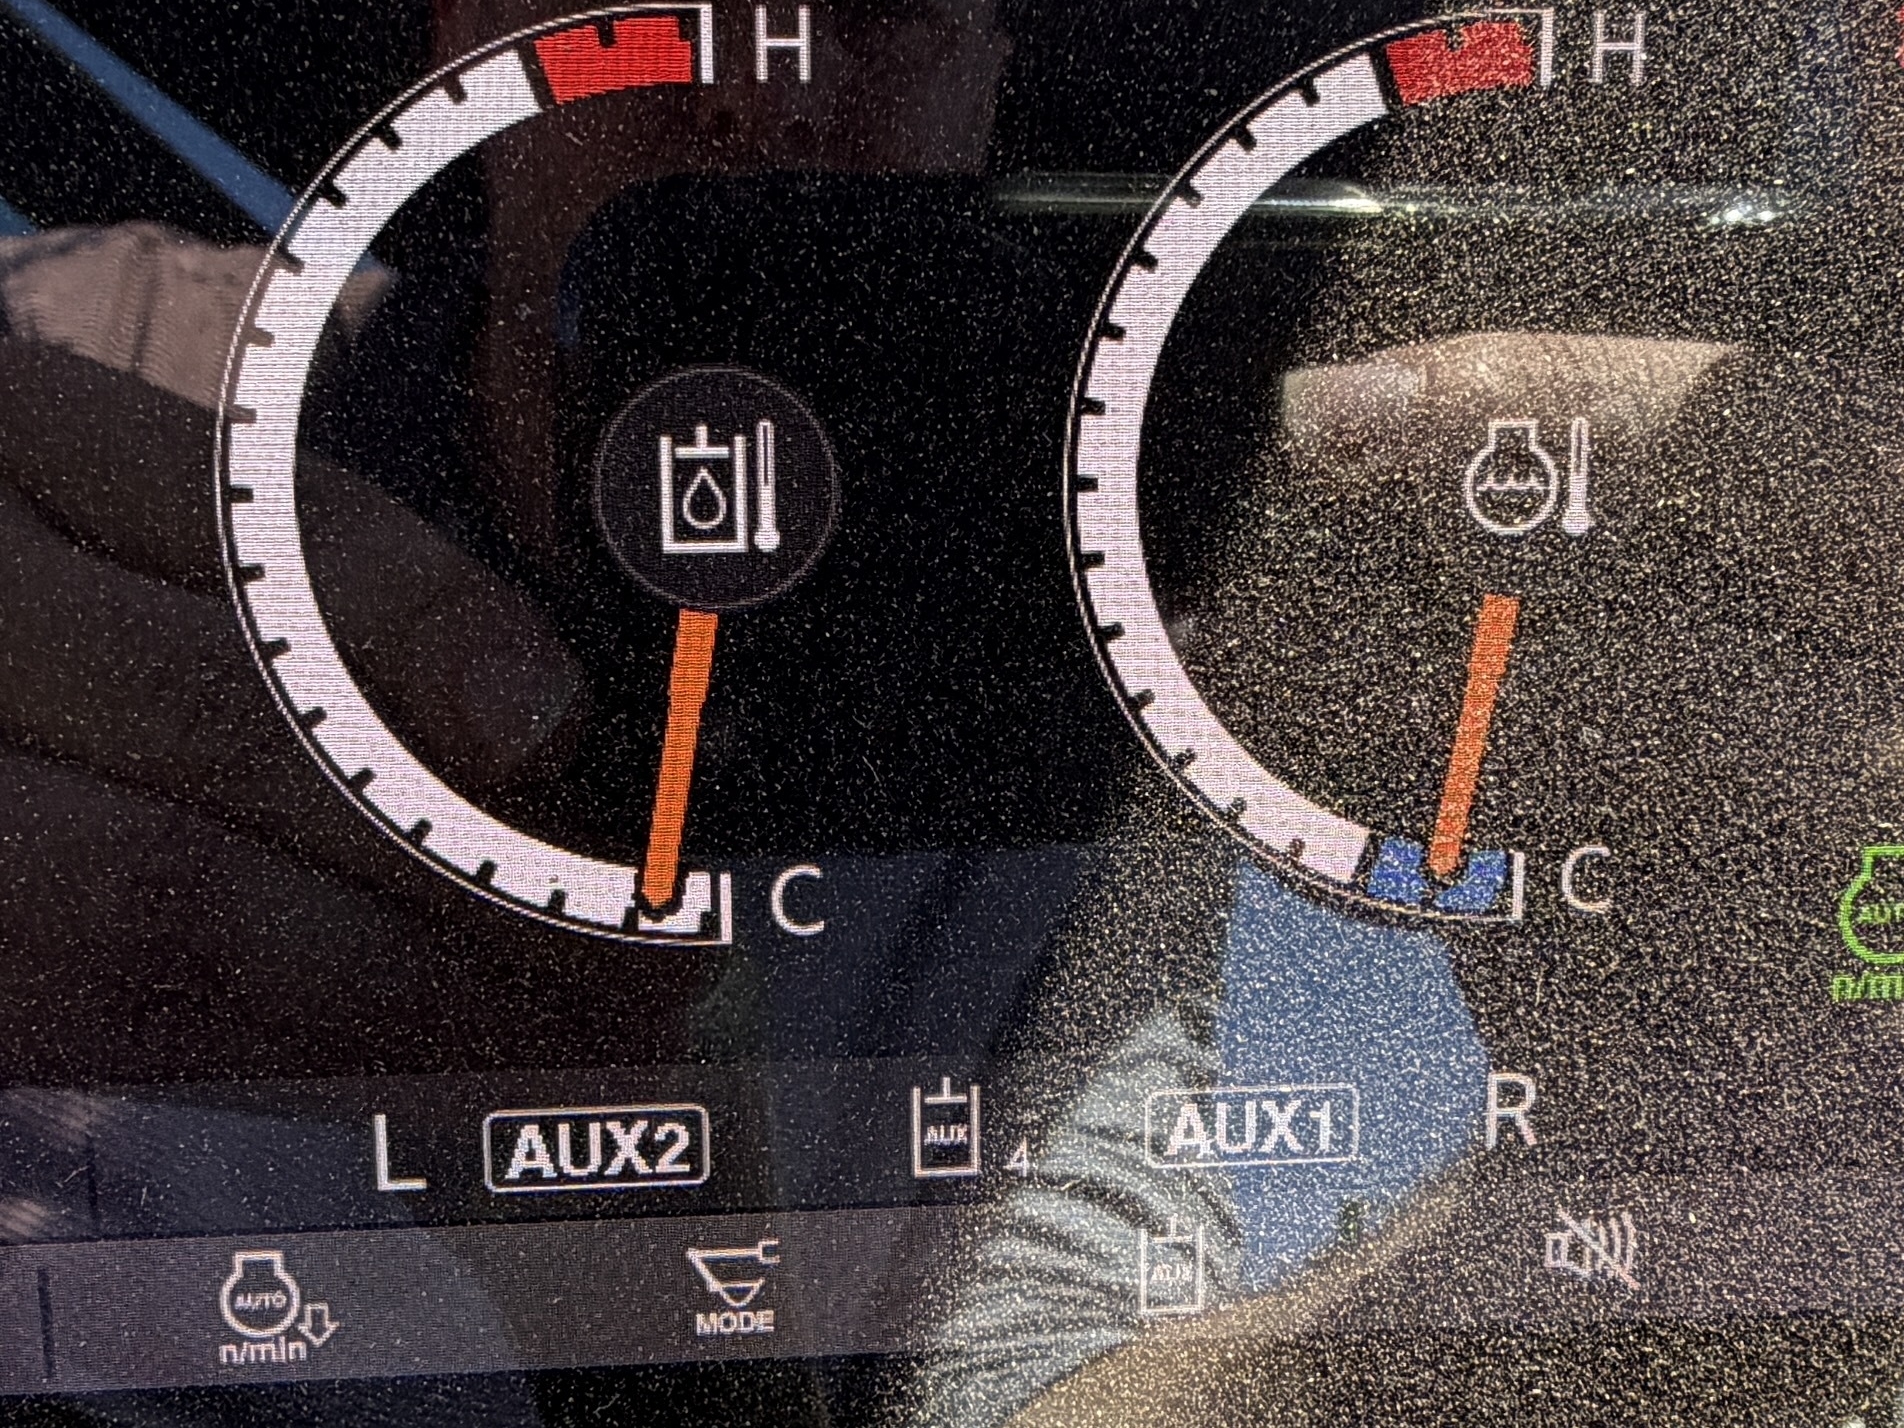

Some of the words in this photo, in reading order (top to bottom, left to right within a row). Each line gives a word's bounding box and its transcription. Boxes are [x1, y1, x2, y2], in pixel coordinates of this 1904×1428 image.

[753, 3, 813, 84] H
[1590, 12, 1645, 86] H
[770, 863, 826, 937] C
[1560, 845, 1611, 914] C
[1166, 1099, 1334, 1159] AUX1
[1484, 1071, 1537, 1151] R
[373, 1113, 428, 1191] L
[504, 1119, 691, 1181] AUX2
[696, 1310, 775, 1336] MODE
